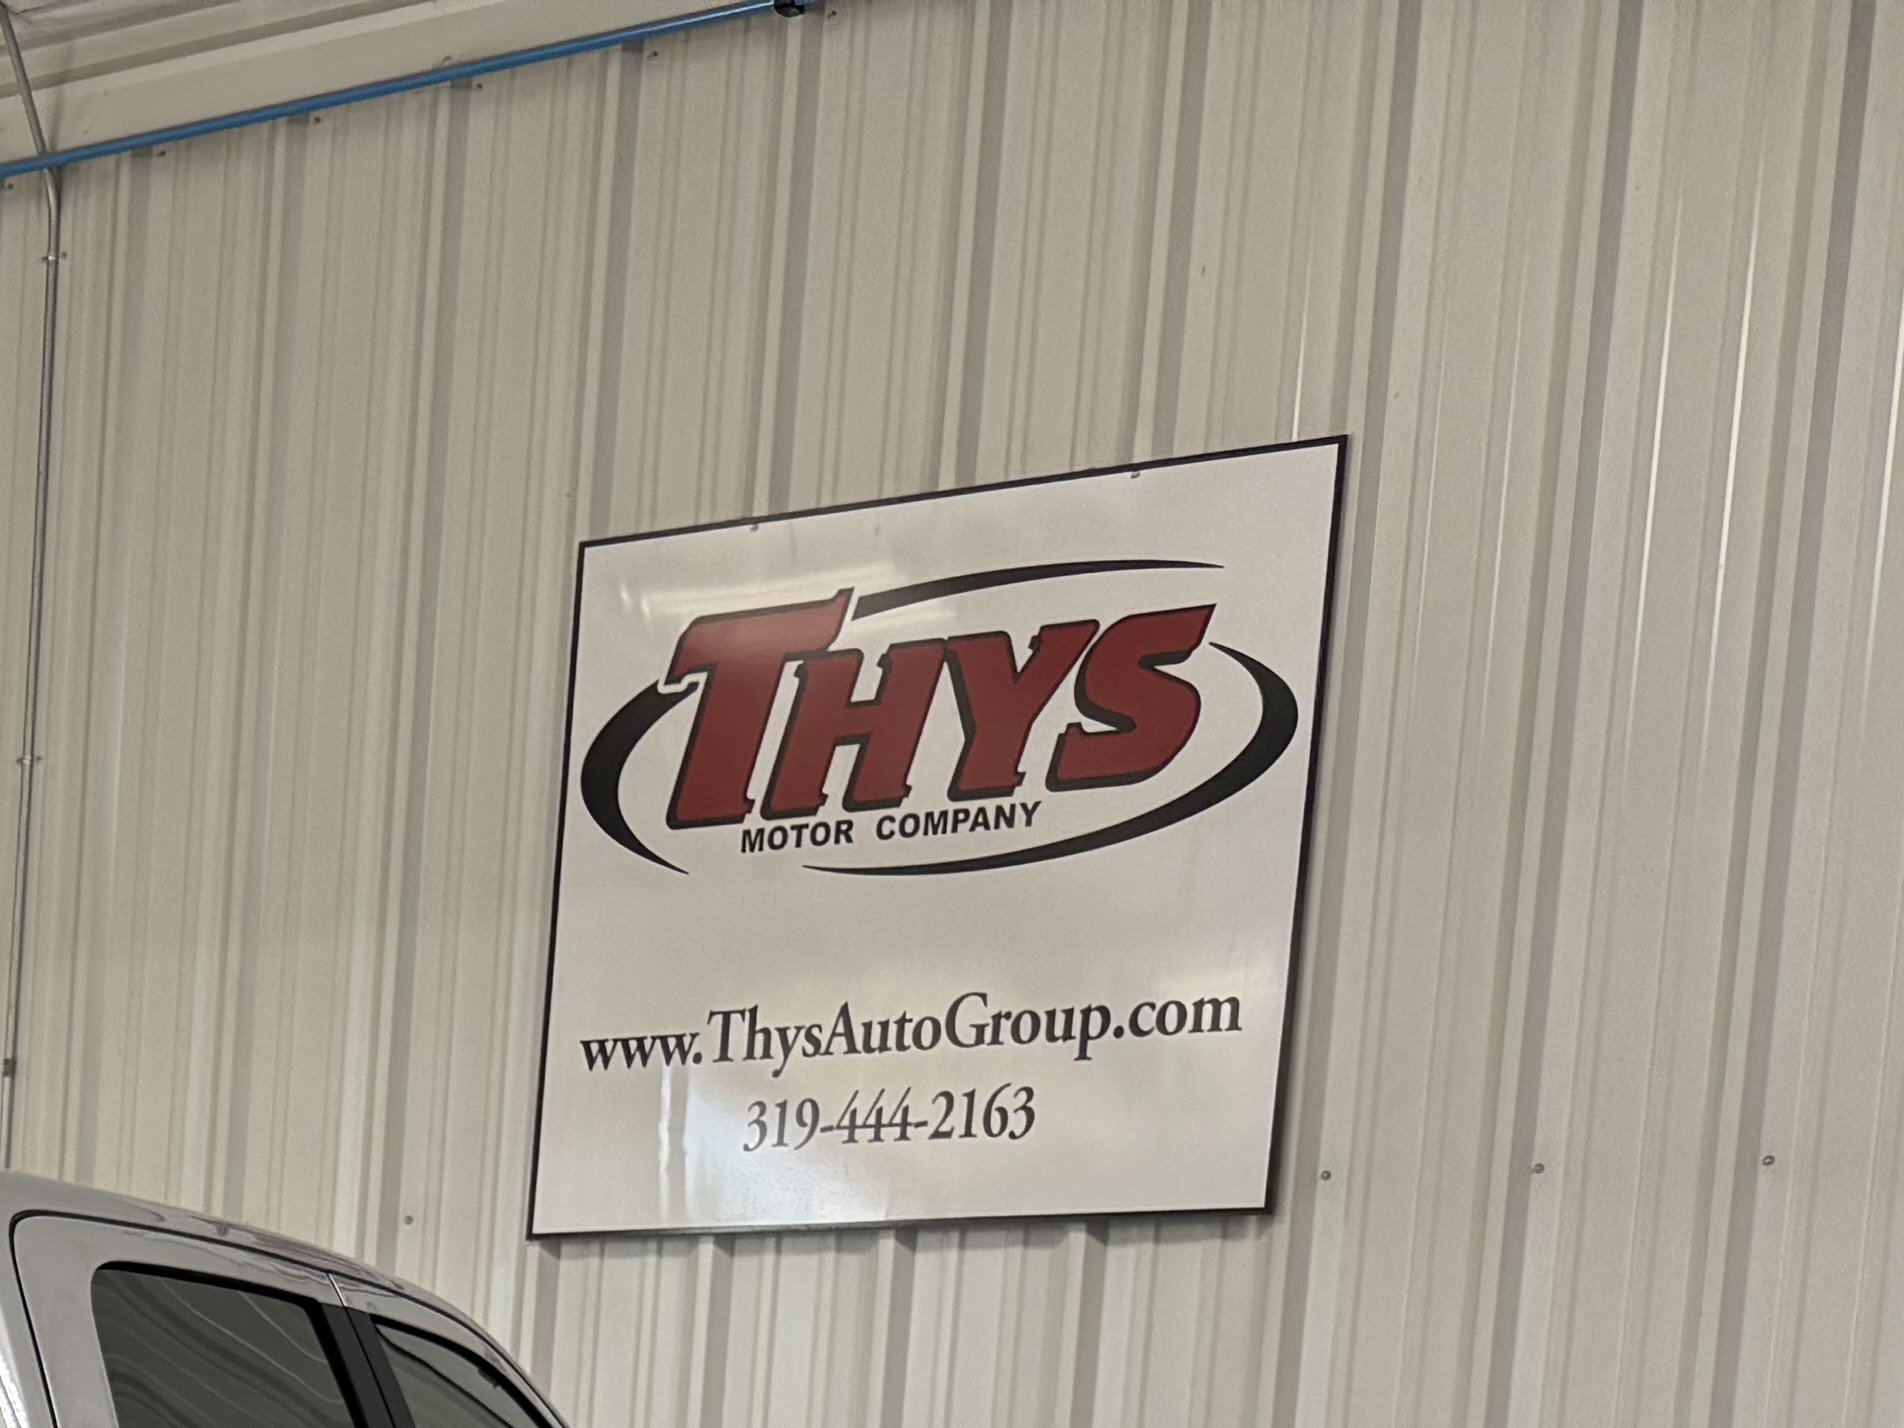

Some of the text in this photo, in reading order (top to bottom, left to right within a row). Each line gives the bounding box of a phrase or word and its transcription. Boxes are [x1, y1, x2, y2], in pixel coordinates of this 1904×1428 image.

[665, 586, 1217, 830] THYS
[740, 801, 1041, 853] MOTOR COMPANY
[580, 992, 1242, 1077] www.ThysAutoGroup.com
[743, 1083, 1036, 1153] 319-444-2163
